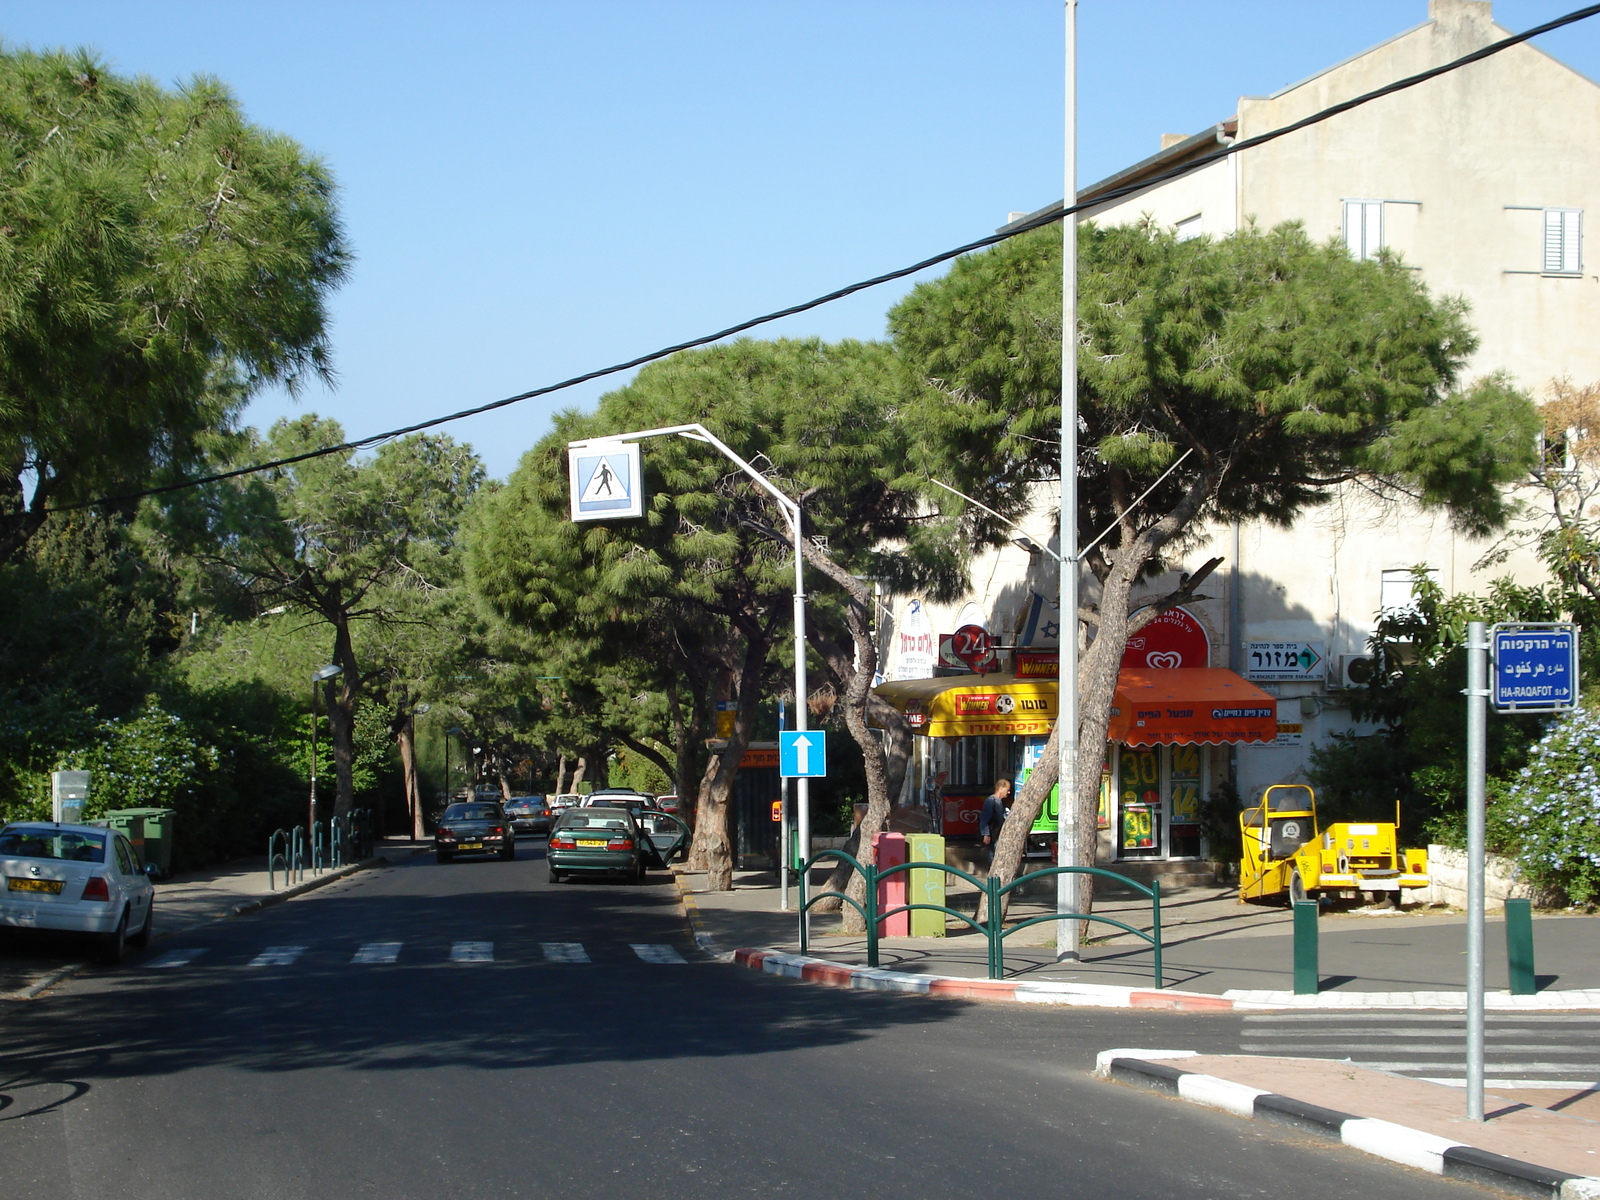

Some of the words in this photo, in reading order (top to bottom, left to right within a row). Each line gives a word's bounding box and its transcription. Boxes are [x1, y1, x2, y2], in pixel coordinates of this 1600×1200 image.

[1164, 610, 1185, 621] דראג
[1163, 617, 1184, 627] גלגלים
[960, 632, 987, 654] 24
[1250, 642, 1270, 650] לנהיגה
[1501, 640, 1549, 652] הרקפות
[1252, 650, 1312, 667] רמזור
[1021, 657, 1059, 675] WINNER
[1547, 663, 1565, 676] شارع
[1501, 686, 1552, 697] HA-RAQAFOT
[960, 696, 990, 711] WINNER
[1020, 699, 1048, 711] טוטו
[1137, 710, 1162, 719] הפיס
[1166, 708, 1194, 718] מפעל
[969, 723, 1001, 734] אורן
[1005, 722, 1039, 732] קפה
[1121, 753, 1158, 785] 30
[1172, 786, 1199, 818] 14
[1124, 812, 1151, 835] 30
